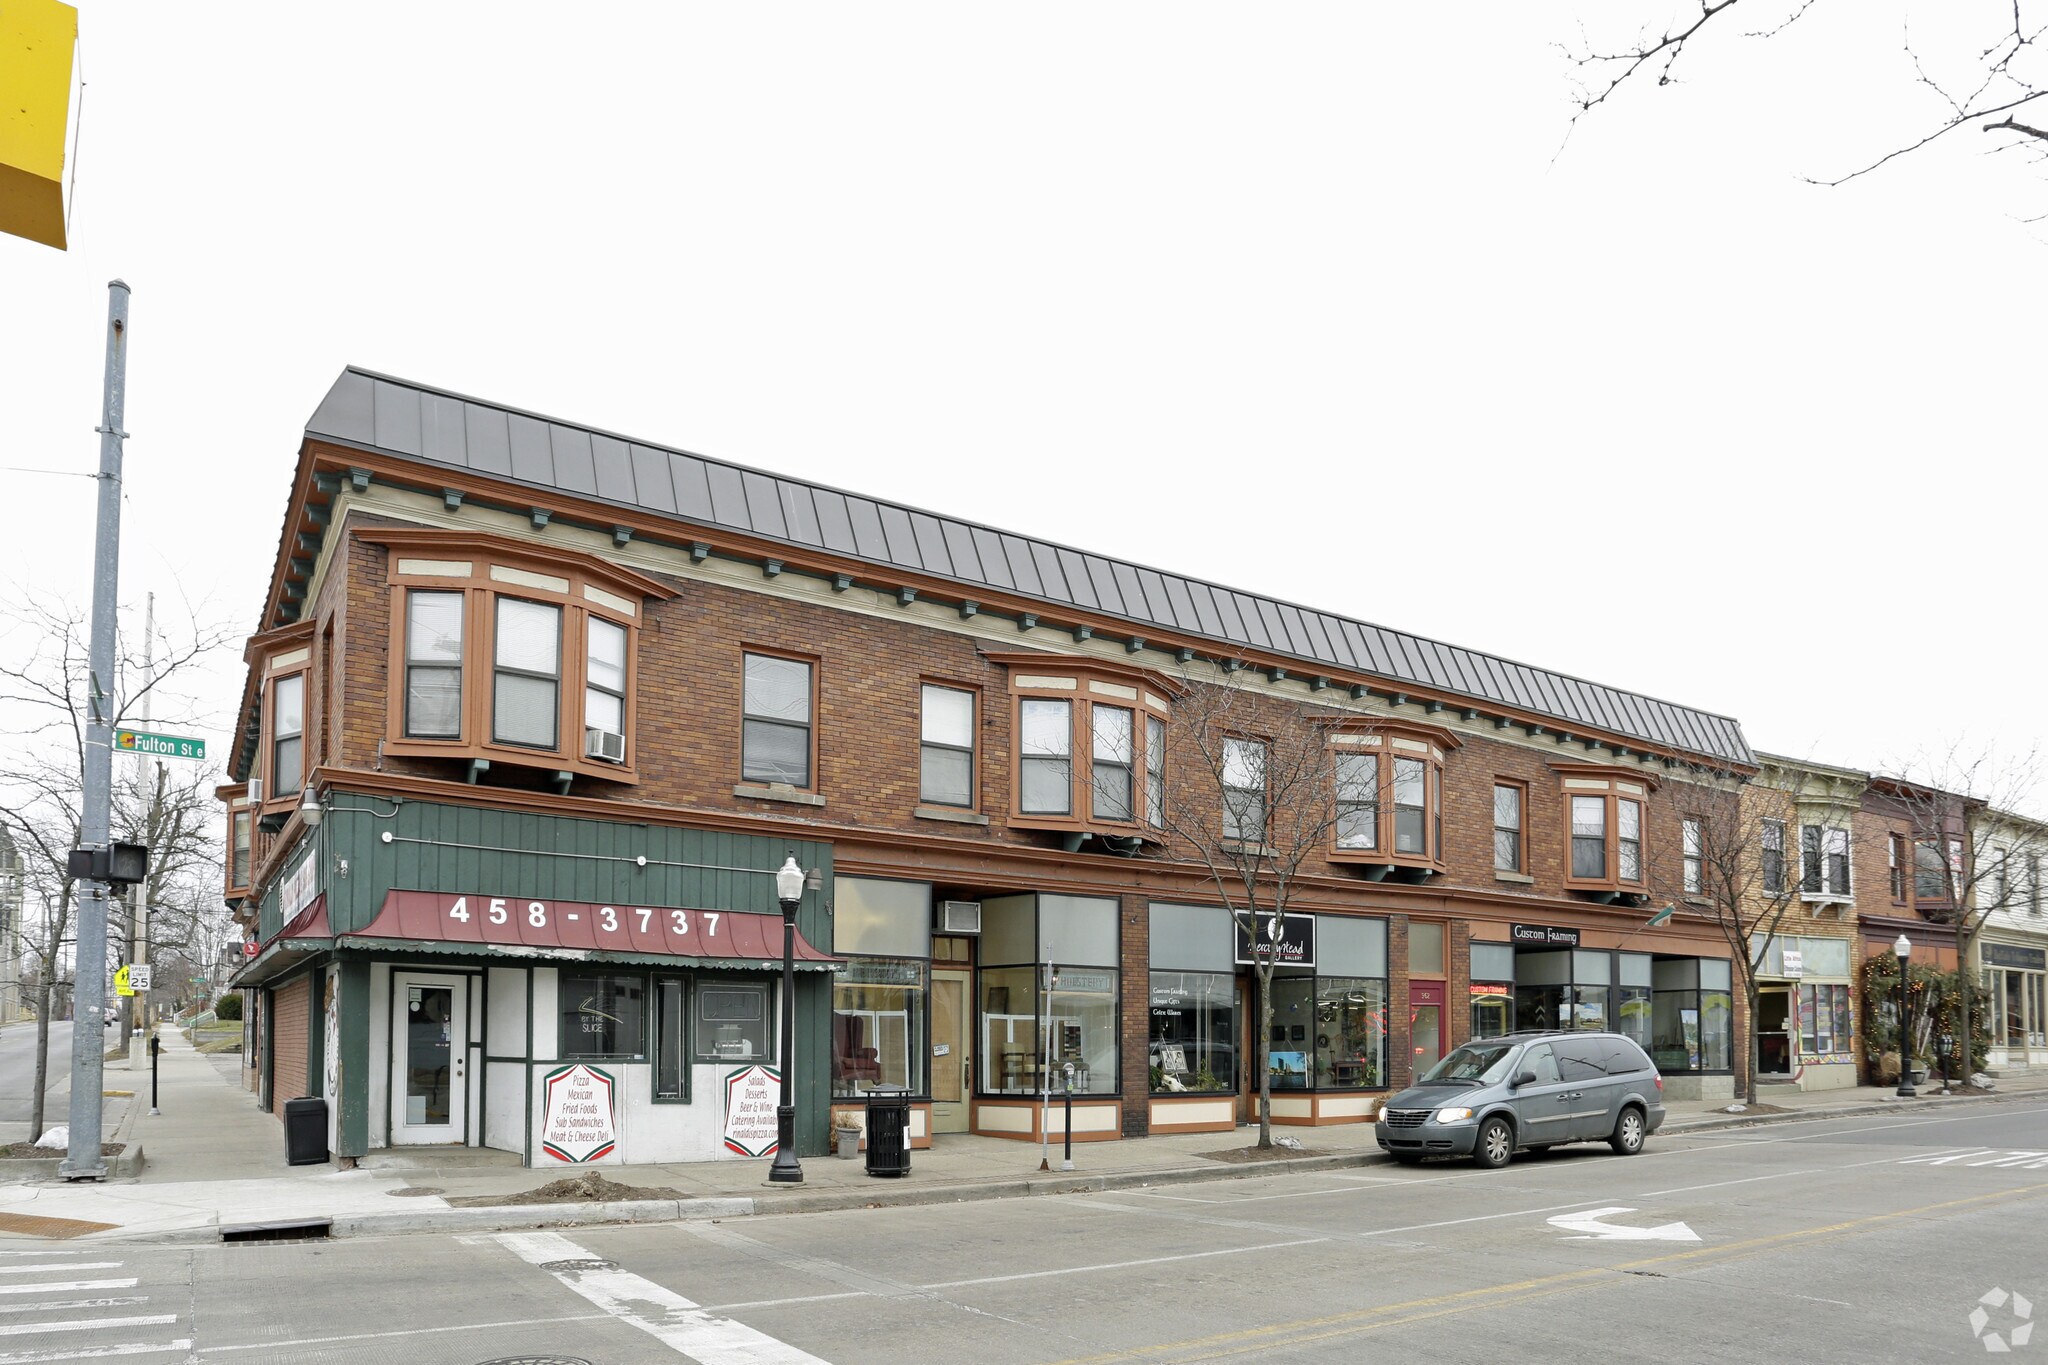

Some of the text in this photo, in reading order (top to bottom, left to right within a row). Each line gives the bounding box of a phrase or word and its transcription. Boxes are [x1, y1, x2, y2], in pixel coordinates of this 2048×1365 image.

[135, 735, 203, 757] Fulton St e
[450, 897, 720, 937] 458-3737
[1514, 924, 1577, 945] Custom Framing
[131, 978, 148, 987] 25
[1470, 985, 1488, 994] CUSTOM
[582, 1023, 603, 1033] SLICE
[572, 1074, 590, 1086] Pizza
[748, 1075, 766, 1086] Salads
[567, 1088, 593, 1100] Mexican
[744, 1088, 768, 1099] Desserts
[562, 1103, 598, 1114] Fried Foods
[739, 1101, 773, 1113] Beer & Wine
[555, 1116, 604, 1128] Sub Sandwiches
[731, 1115, 778, 1127] Catering Availab
[550, 1130, 609, 1142] Meat & Cheese Deli
